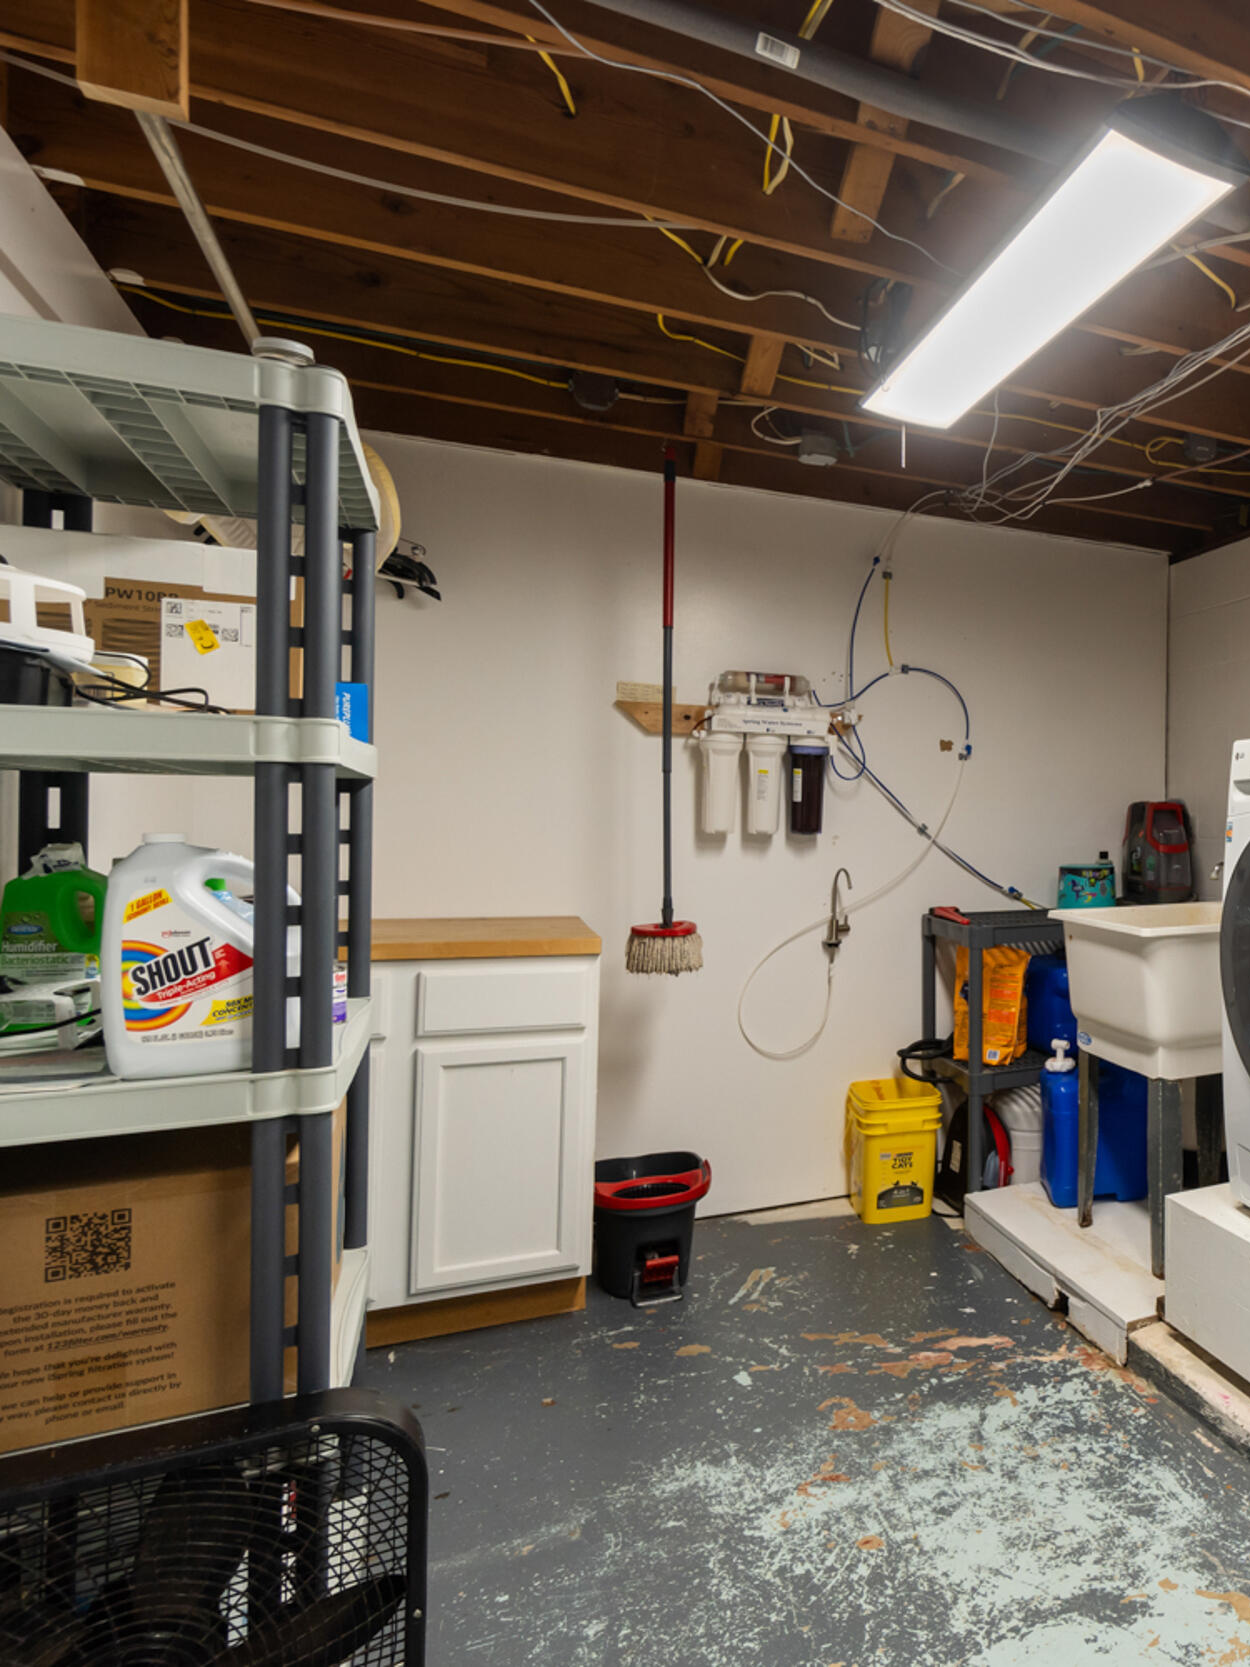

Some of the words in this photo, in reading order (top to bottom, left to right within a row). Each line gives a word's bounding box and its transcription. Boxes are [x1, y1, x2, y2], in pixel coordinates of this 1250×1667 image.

[2, 940, 58, 952] Humidifier
[131, 936, 211, 996] SHOUT
[156, 971, 216, 1000] Triple-Acting
[74, 1290, 120, 1303] required
[122, 1288, 133, 1296] to
[135, 1281, 176, 1294] activate
[13, 1314, 32, 1324] the
[34, 1307, 72, 1321] 30-day
[74, 1302, 111, 1315] money
[113, 1297, 137, 1308] back
[139, 1293, 160, 1303] and
[51, 1310, 123, 1329] manufacturer
[89, 1320, 123, 1334] please
[125, 1315, 139, 1326] fill
[141, 1314, 158, 1324] out
[160, 1311, 178, 1321] the
[4, 1347, 31, 1359] form
[33, 1344, 45, 1353] at
[13, 1365, 41, 1378] hope
[44, 1361, 66, 1372] that
[68, 1355, 101, 1368] you're
[103, 1344, 153, 1361] delighted
[155, 1341, 177, 1351] with
[21, 1376, 45, 1386] new
[88, 1359, 133, 1374] filtration
[1, 1402, 18, 1412] we
[20, 1398, 41, 1408] can
[43, 1392, 66, 1404] help
[82, 1382, 123, 1397] provide
[125, 1374, 165, 1387] support
[34, 1402, 69, 1416] please
[72, 1394, 112, 1408] contact
[114, 1391, 126, 1400] us
[128, 1382, 167, 1398] directly
[169, 1380, 182, 1390] by
[45, 1409, 79, 1425] phone
